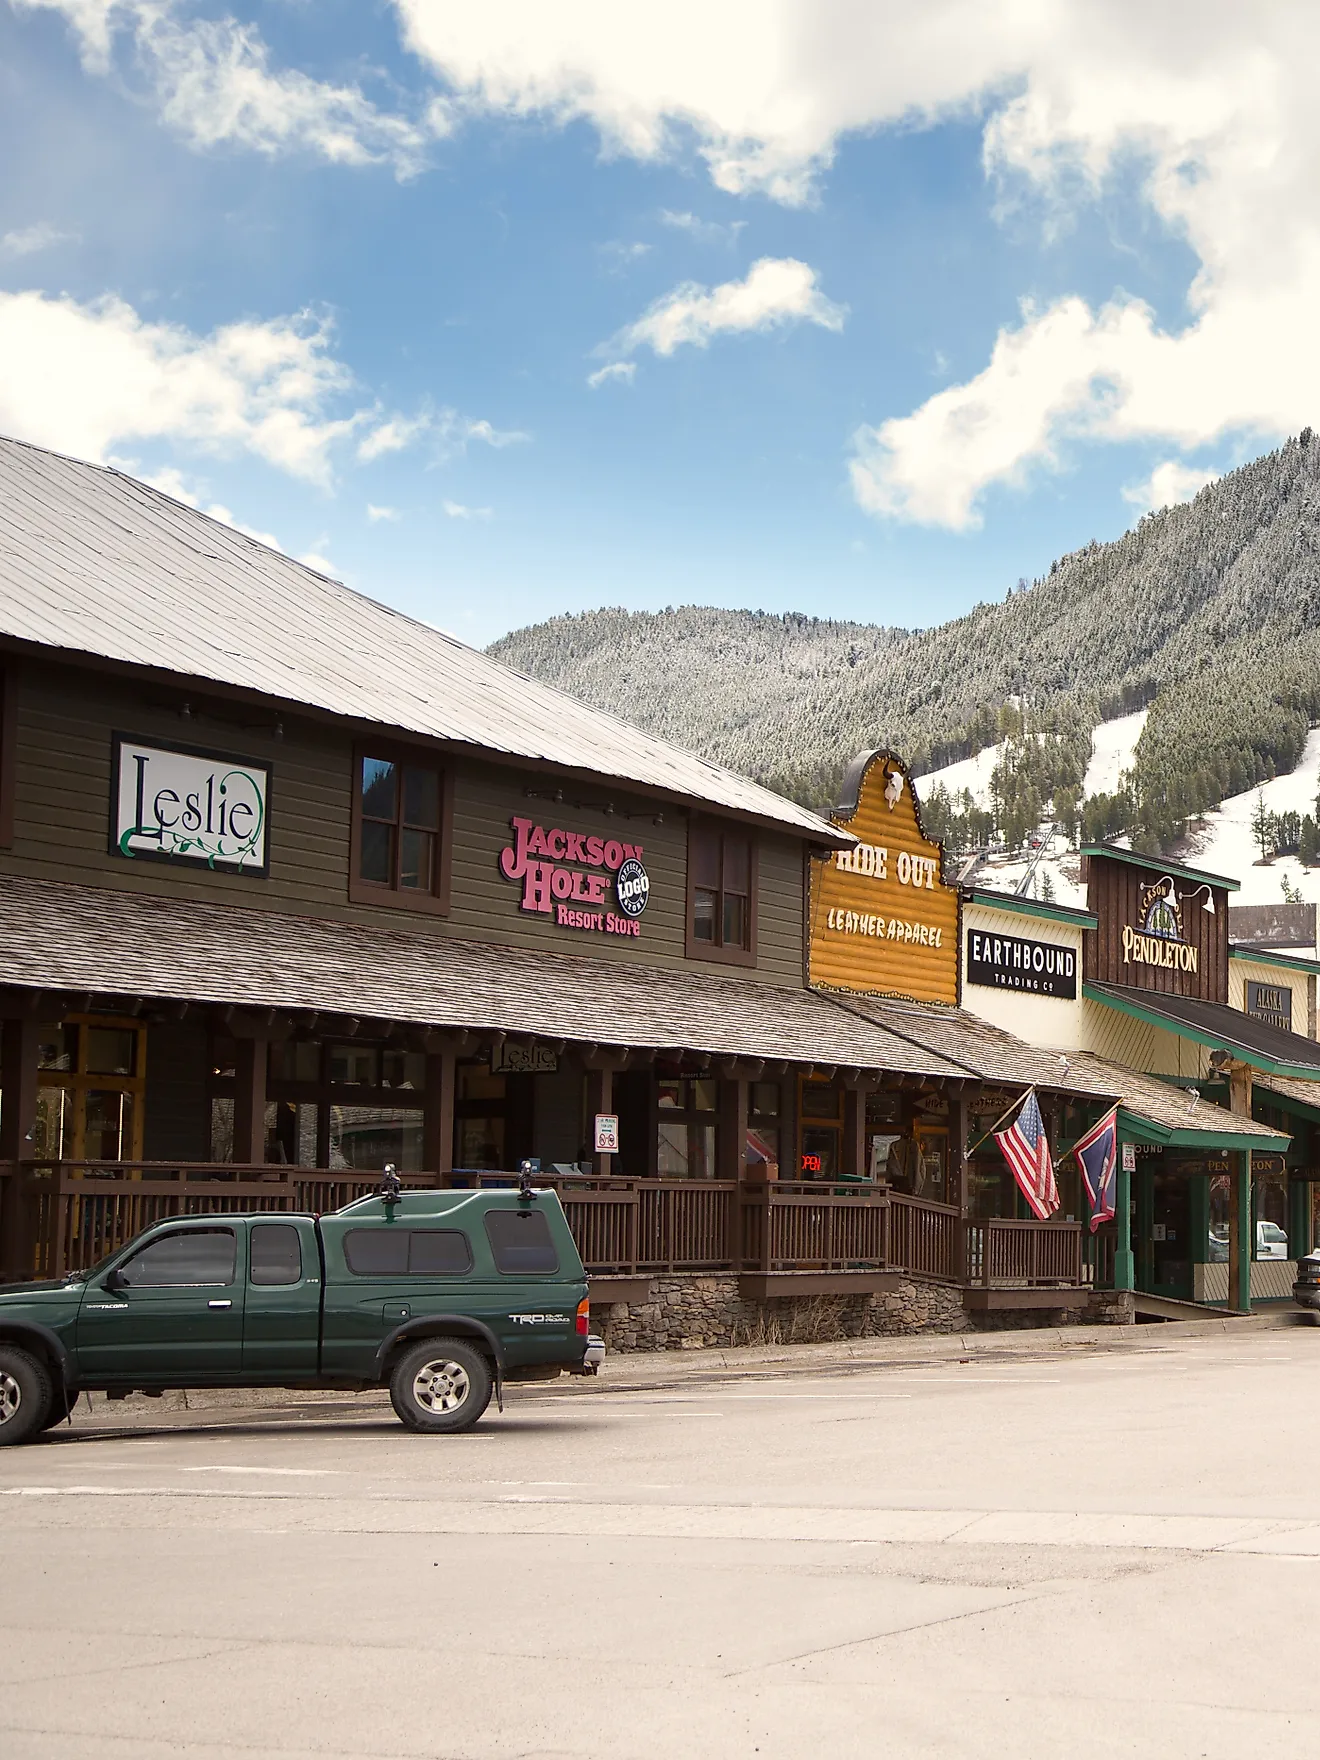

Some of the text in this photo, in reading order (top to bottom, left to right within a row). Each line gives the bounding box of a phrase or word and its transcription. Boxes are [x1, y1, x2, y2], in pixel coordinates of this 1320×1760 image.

[132, 755, 254, 844] Leslie
[501, 816, 643, 879] JACKSON
[521, 860, 606, 913] HOLE
[617, 876, 650, 900] LOGO
[897, 851, 937, 889] OUT
[557, 903, 641, 937] Resort Store
[828, 908, 942, 948] LEATHER APPAREL
[973, 935, 1074, 977] EARTHBOUND
[1122, 925, 1198, 973] PENDLETON
[994, 973, 1039, 990] TRADING
[1256, 987, 1283, 1012] ALASKA
[499, 1043, 557, 1069] Leslie
[508, 1314, 544, 1325] TRD
